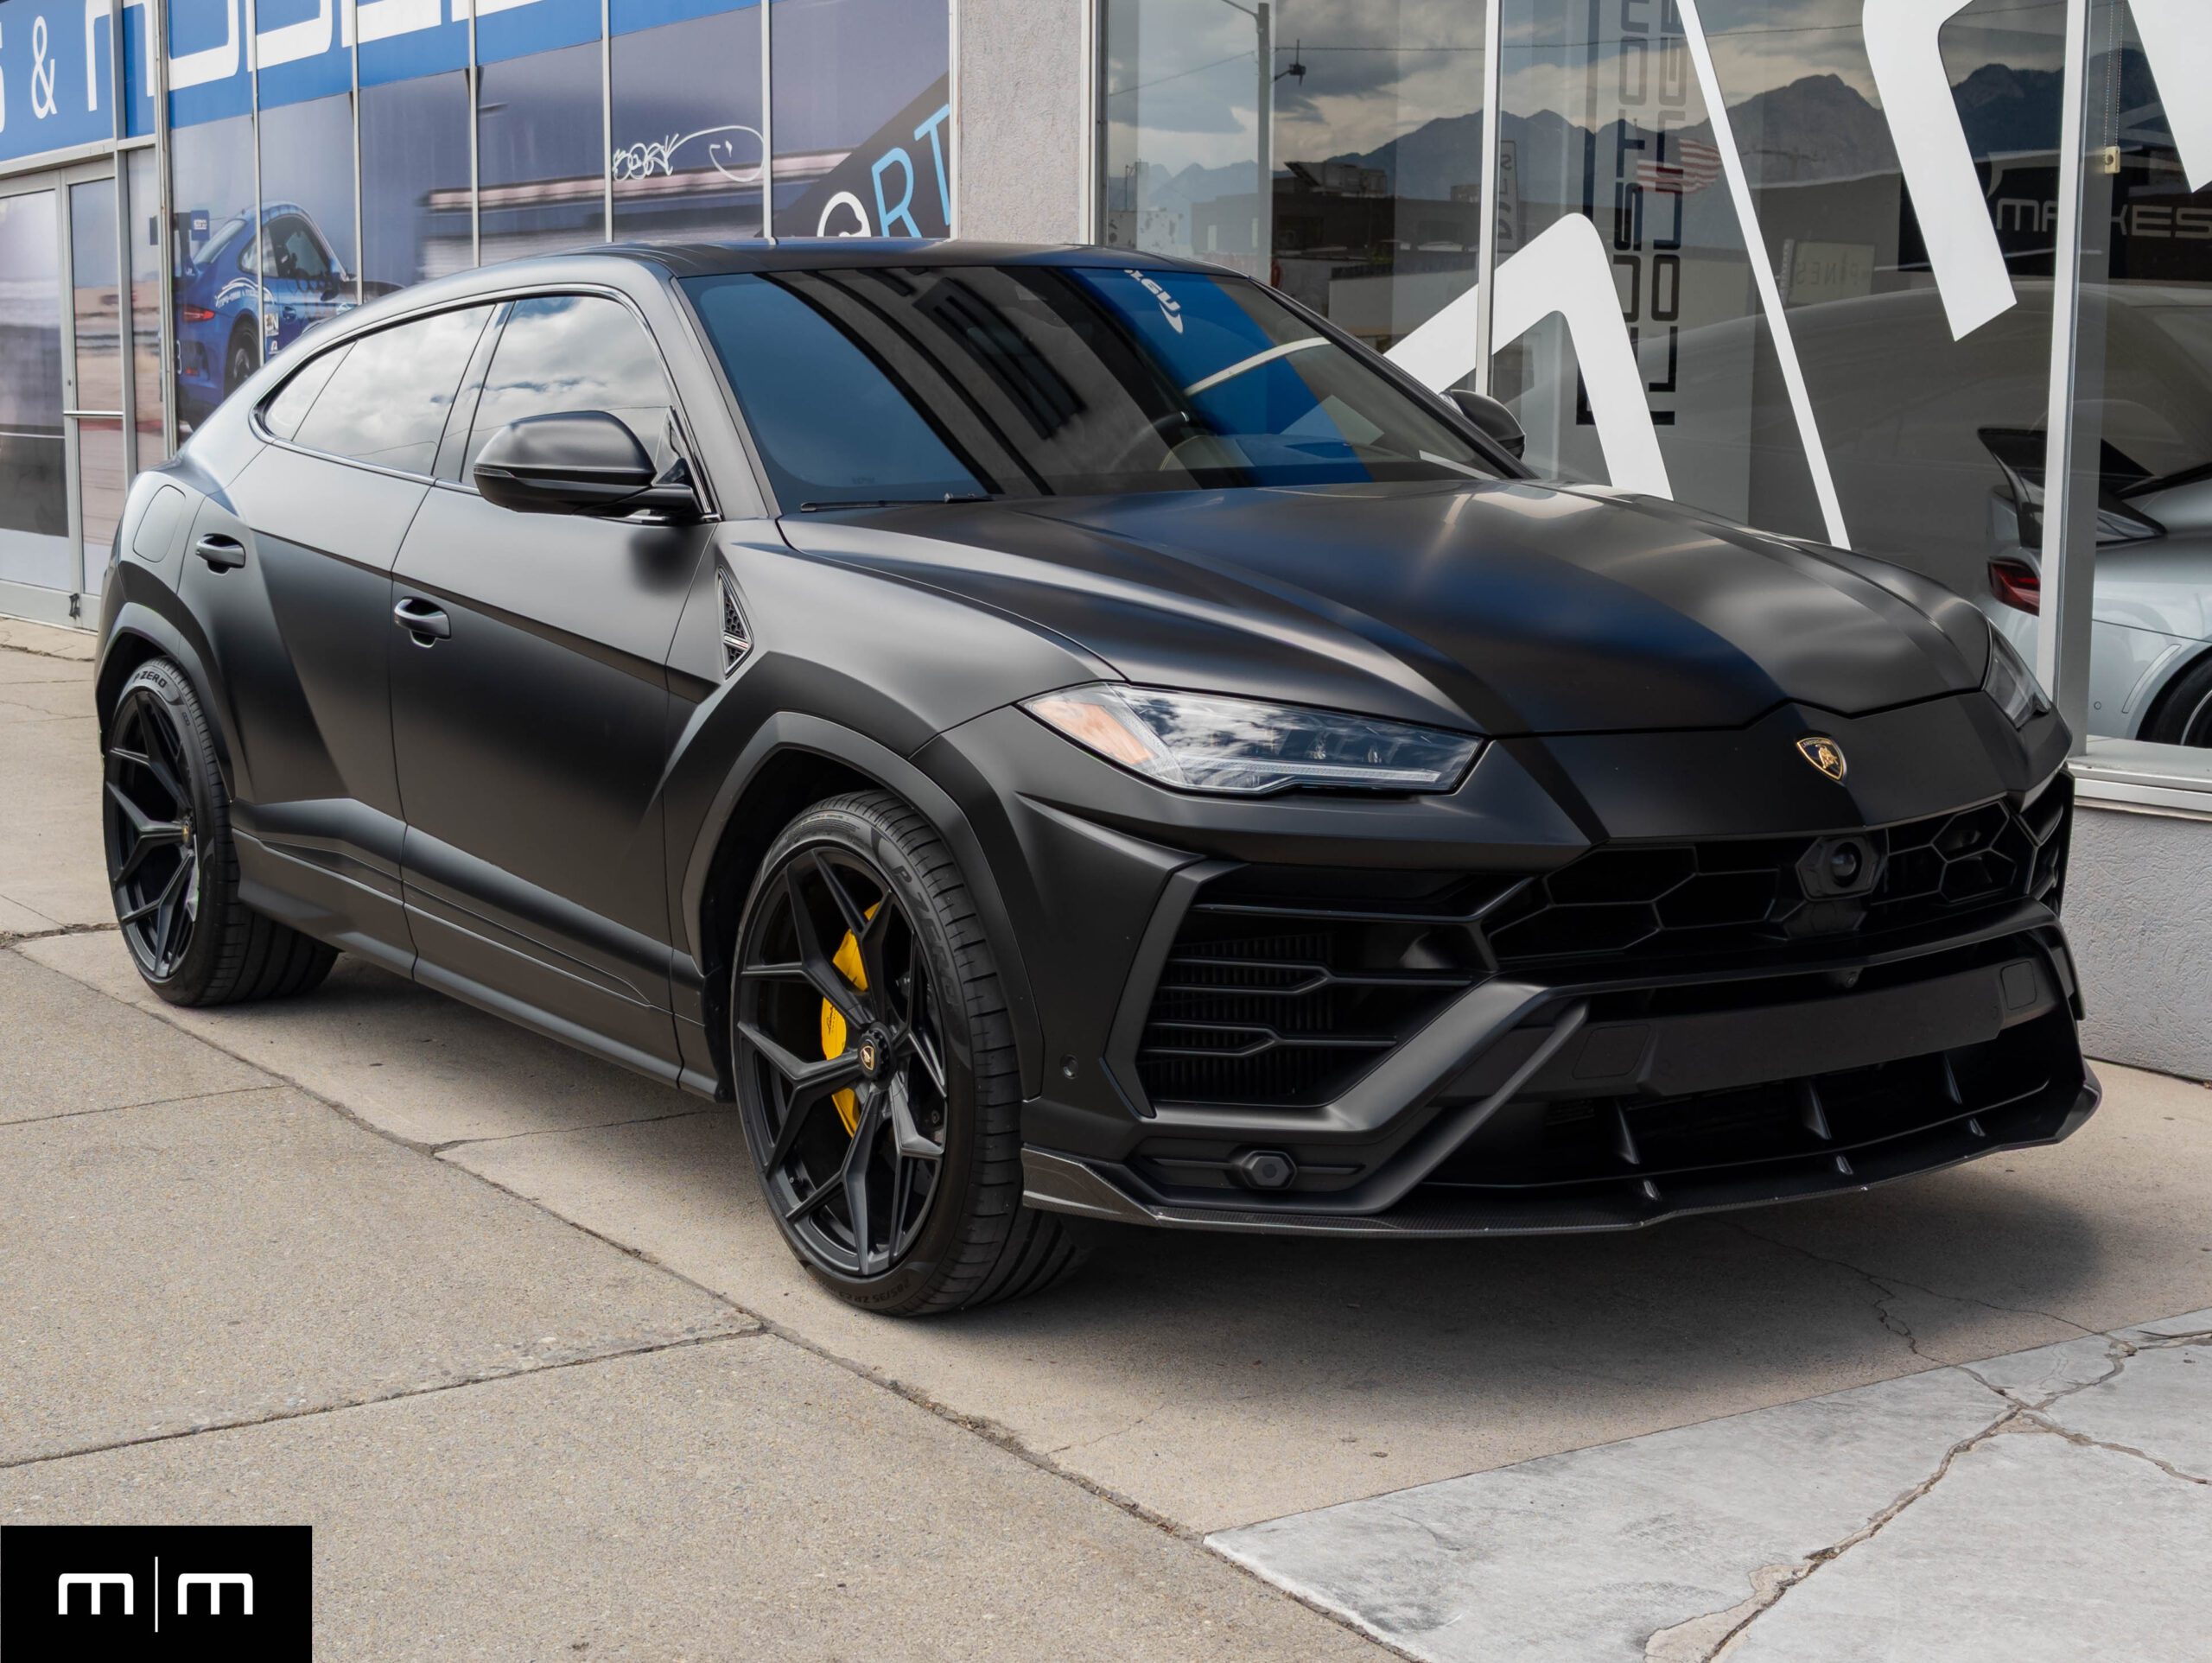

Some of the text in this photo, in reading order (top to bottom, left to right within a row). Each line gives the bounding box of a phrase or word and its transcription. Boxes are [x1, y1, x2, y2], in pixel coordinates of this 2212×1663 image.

[31, 16, 58, 119] &
[140, 670, 168, 689] ZERO
[892, 865, 913, 884] P
